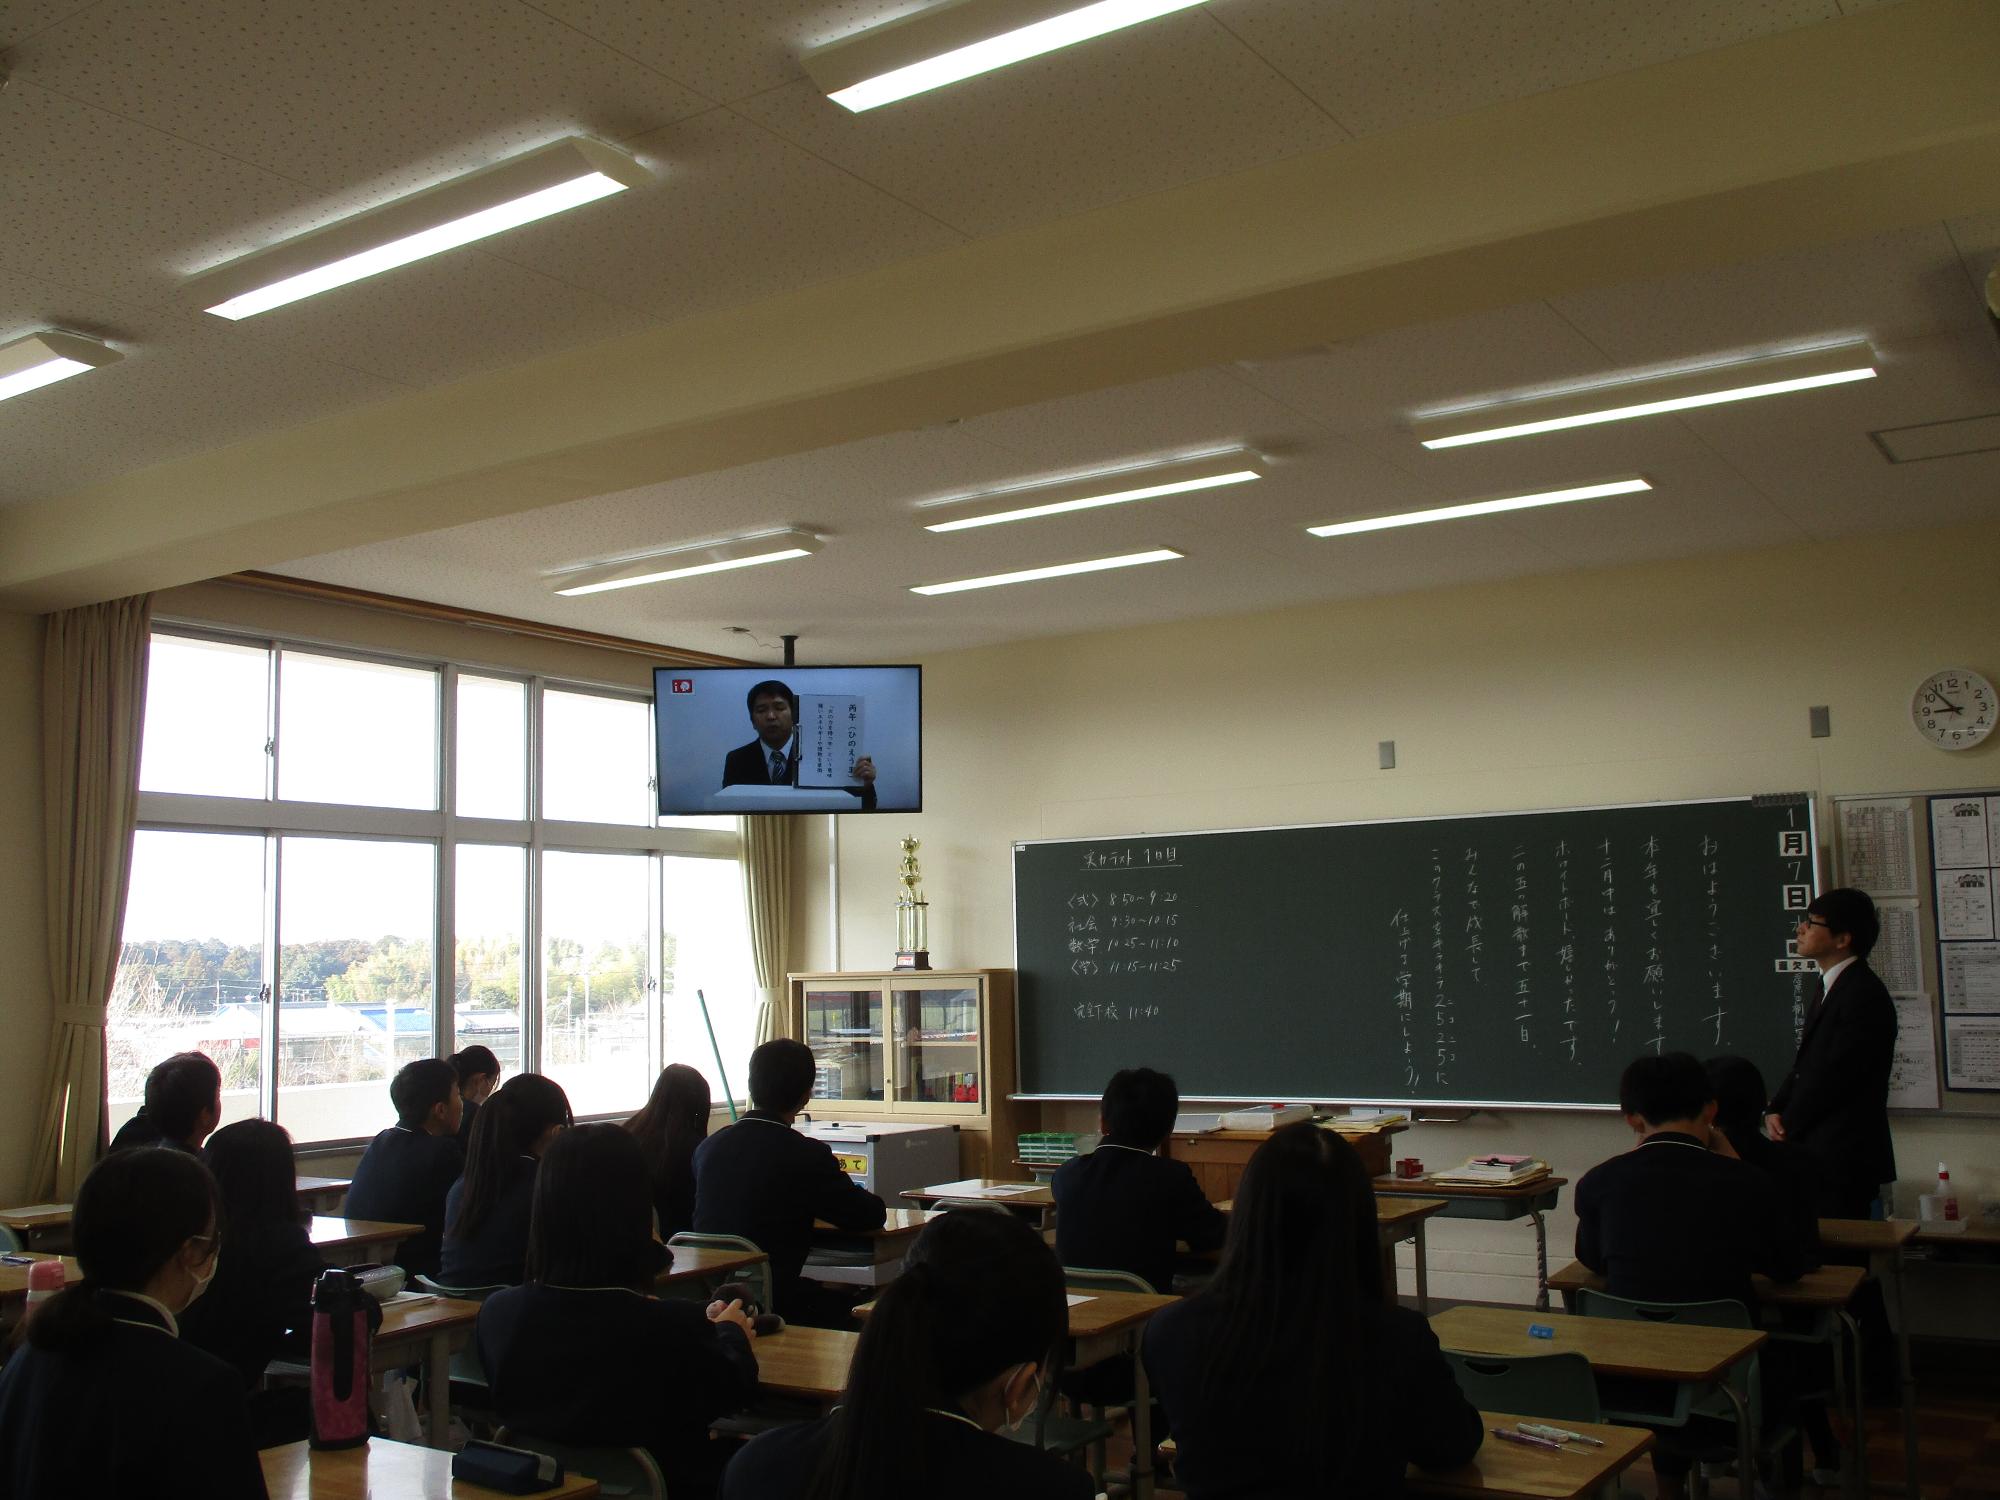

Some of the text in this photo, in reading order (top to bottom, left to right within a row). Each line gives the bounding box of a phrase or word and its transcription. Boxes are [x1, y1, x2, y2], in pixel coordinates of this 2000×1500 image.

[1934, 683, 1943, 692] 11
[1946, 679, 1958, 688] 12
[1925, 693, 1936, 703] 10
[1974, 689, 1982, 699] 2
[1922, 707, 1930, 716] 9
[1979, 702, 1987, 711] 3
[1927, 719, 1936, 729] 8
[1976, 716, 1984, 724] 4
[1939, 728, 1946, 738] 7
[1952, 731, 1961, 740] 6
[1967, 726, 1976, 736] 5
[1067, 916, 1098, 933] 社会
[1068, 937, 1100, 955] 数学
